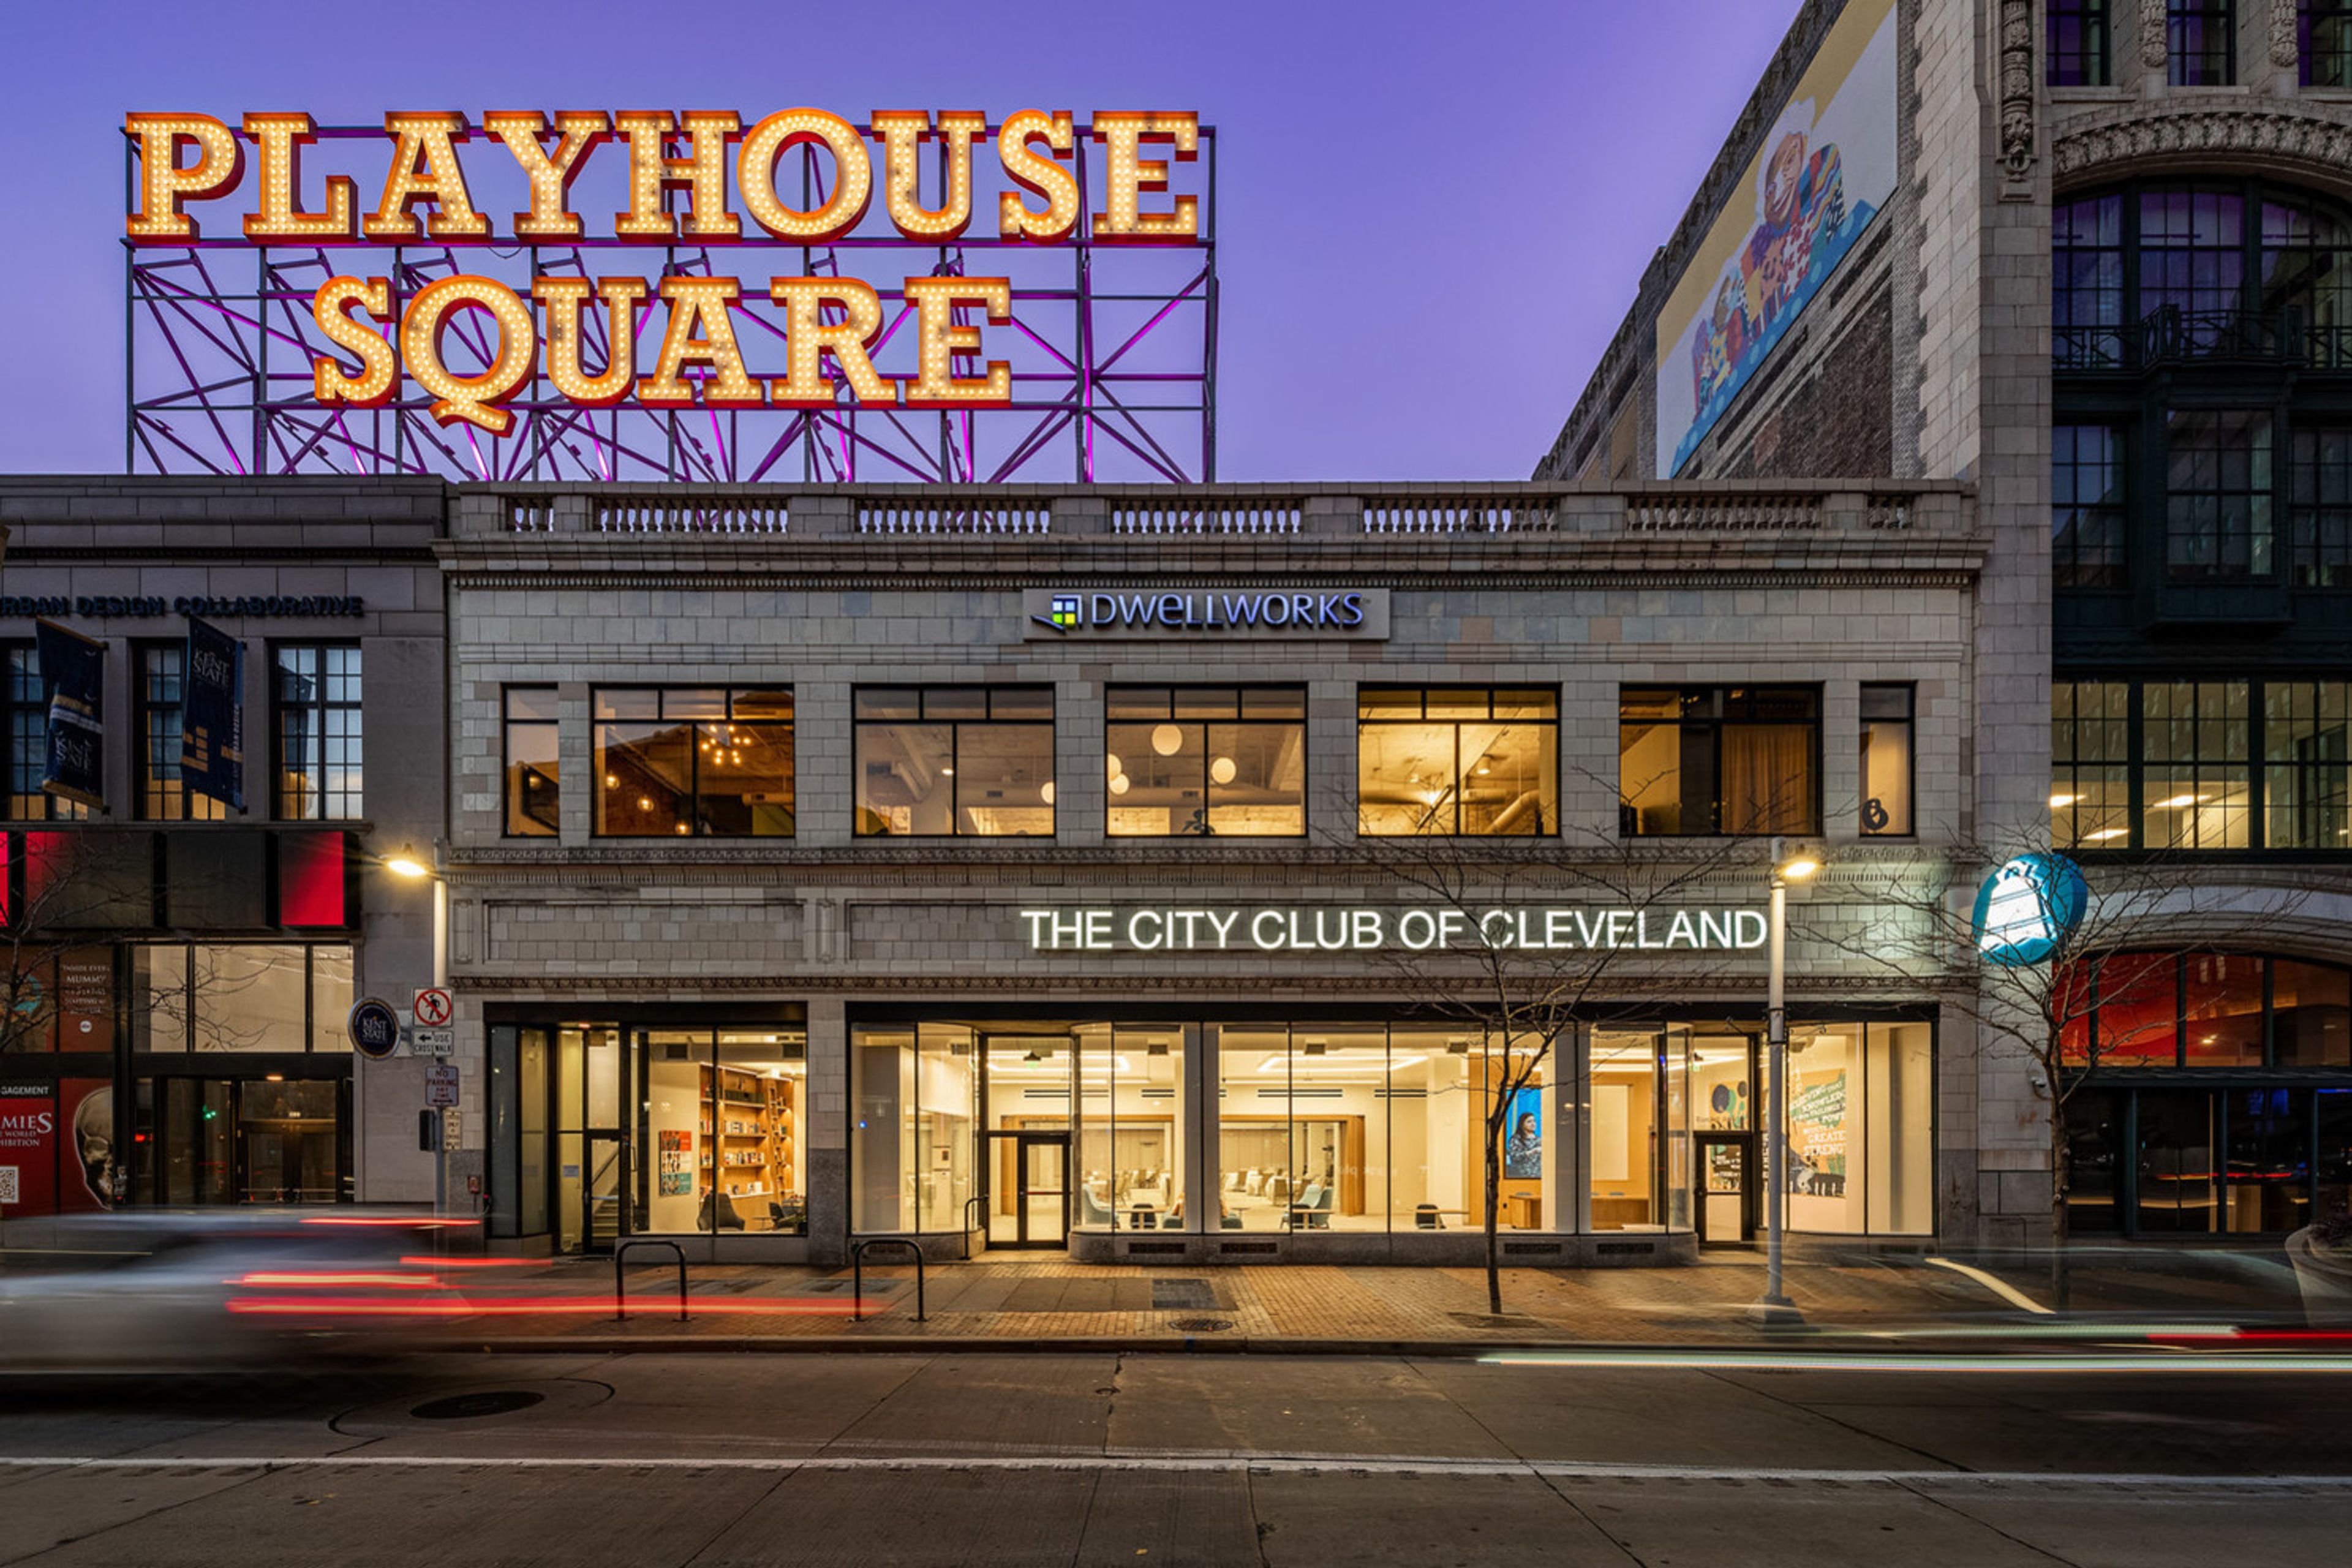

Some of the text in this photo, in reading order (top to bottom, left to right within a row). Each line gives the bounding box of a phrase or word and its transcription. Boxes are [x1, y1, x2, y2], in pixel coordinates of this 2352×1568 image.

[126, 108, 1199, 244] PLAYHOUSE
[314, 274, 1011, 437] SQUARE
[76, 596, 165, 616] DESIGN
[174, 596, 364, 616] COLLABORATIVE
[1020, 910, 1768, 949] THE CITY CLUB OF CLEVELAND
[363, 1018, 386, 1030] KENT
[363, 1029, 387, 1041] STATE
